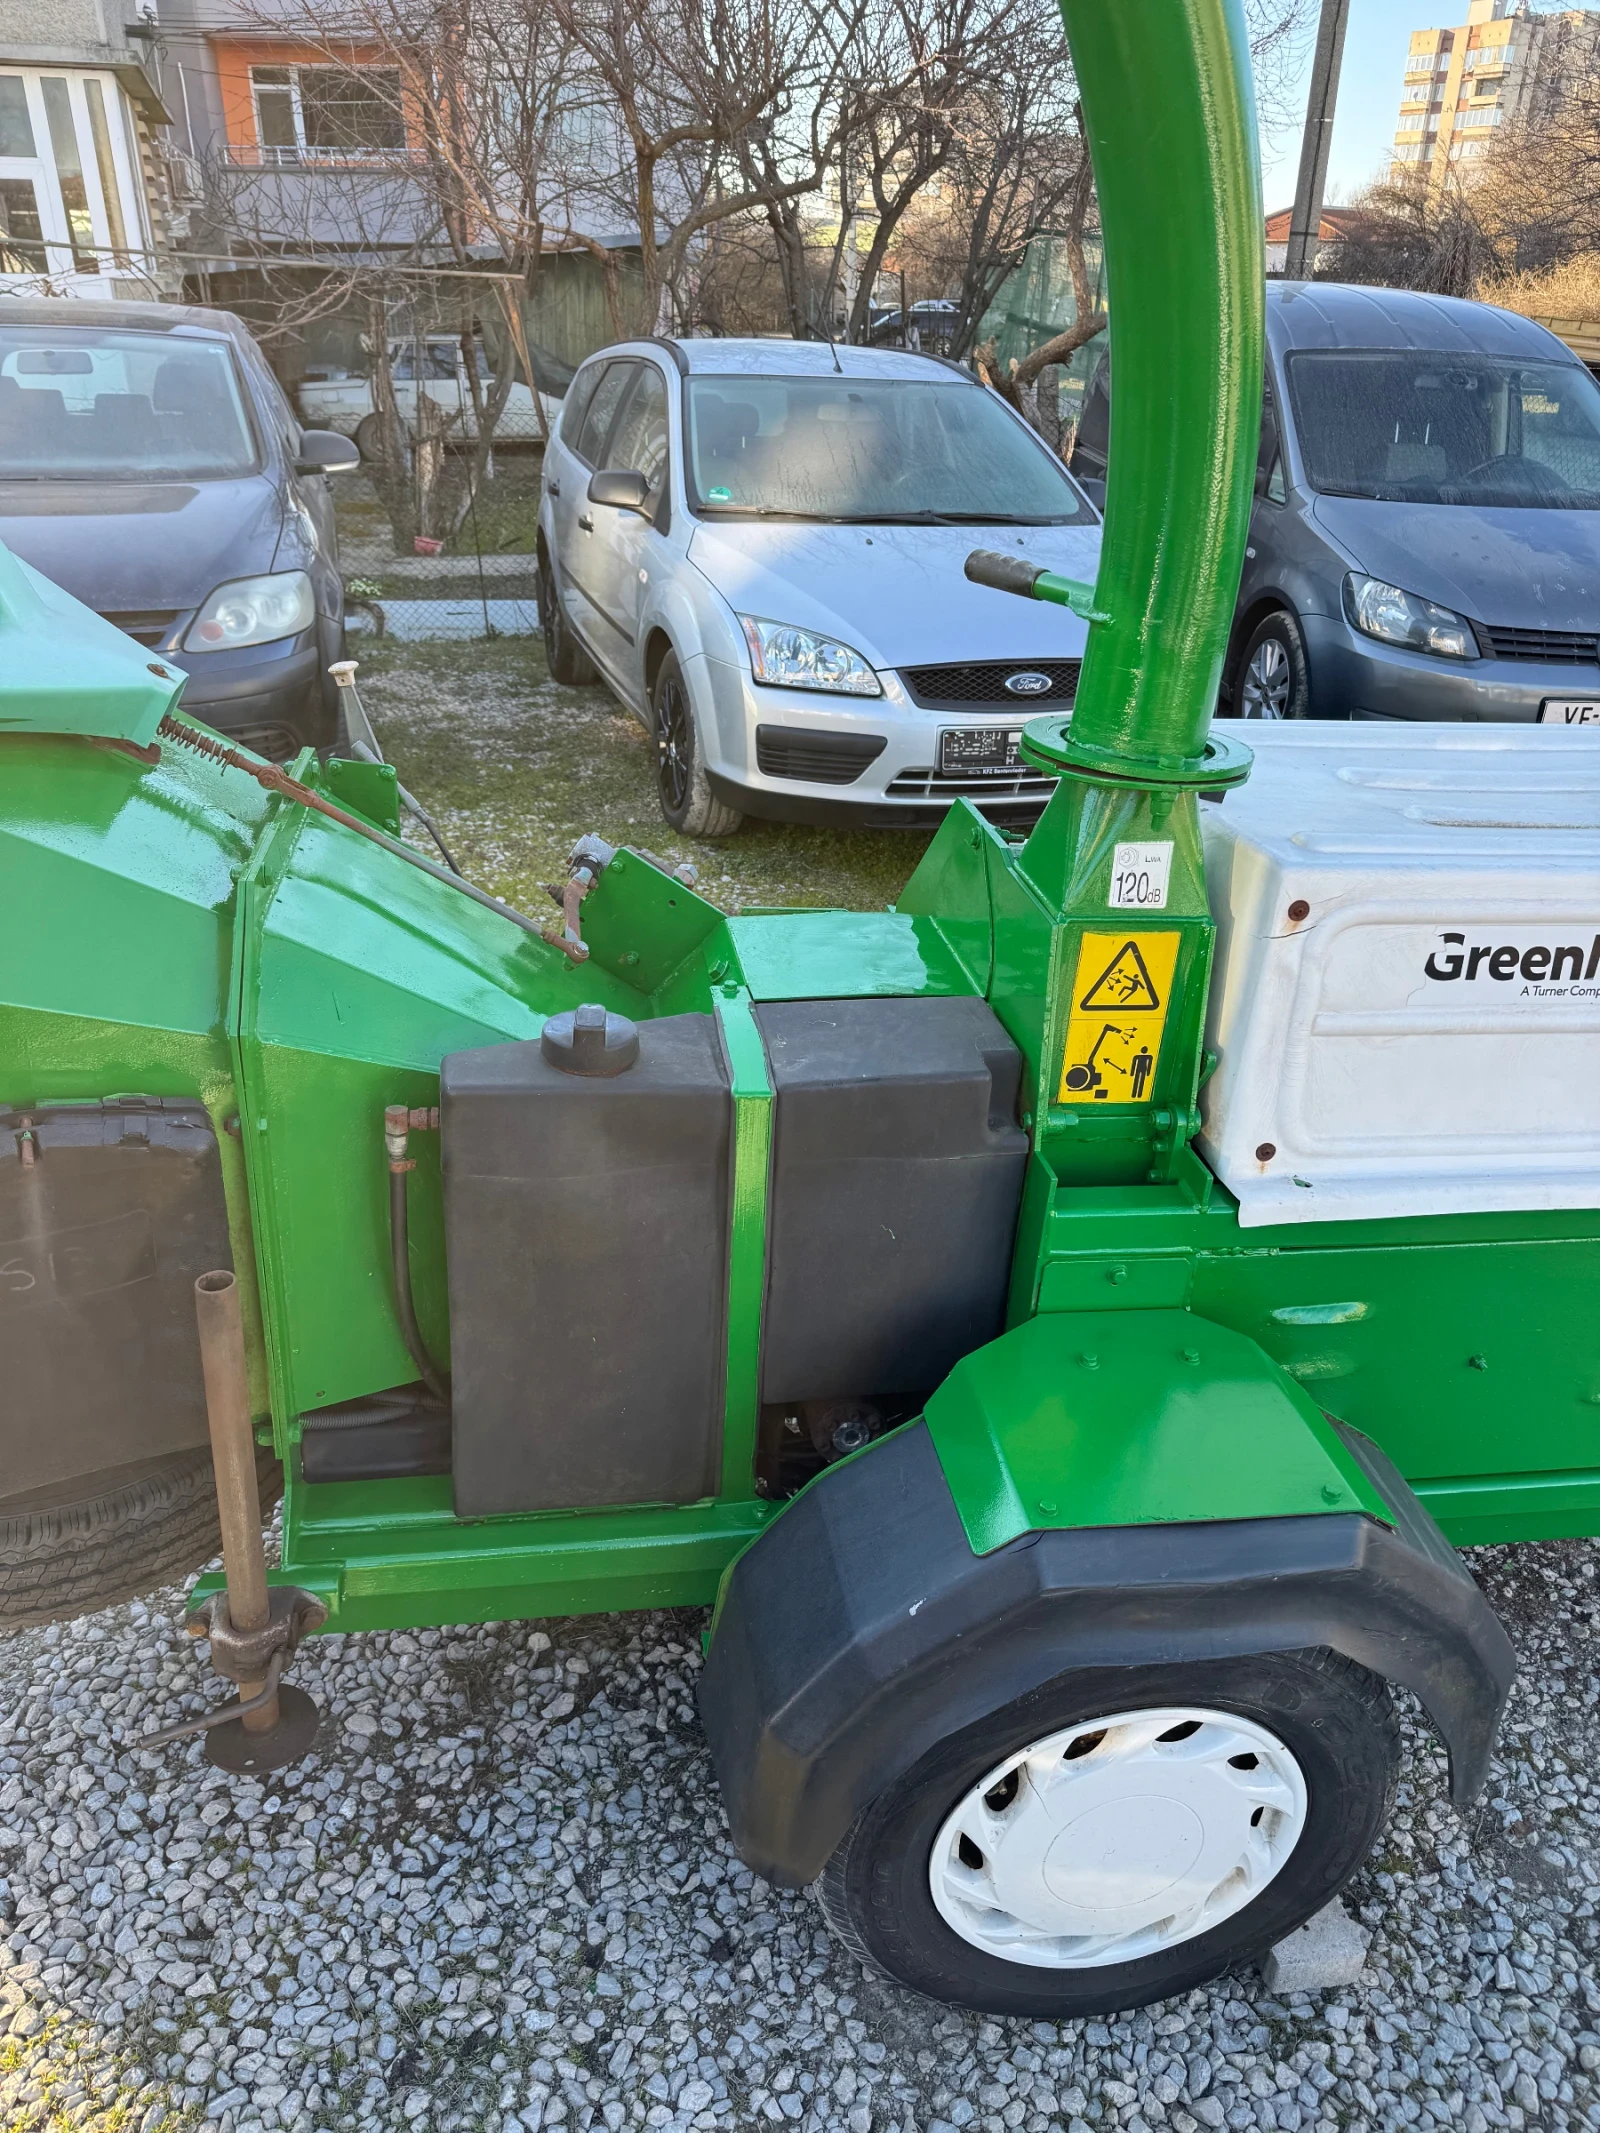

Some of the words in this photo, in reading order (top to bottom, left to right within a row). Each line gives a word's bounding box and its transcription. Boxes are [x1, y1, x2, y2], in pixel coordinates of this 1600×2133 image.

[1017, 677, 1043, 690] Ford
[1519, 985, 1530, 997] A
[1532, 985, 1569, 997] Turner
